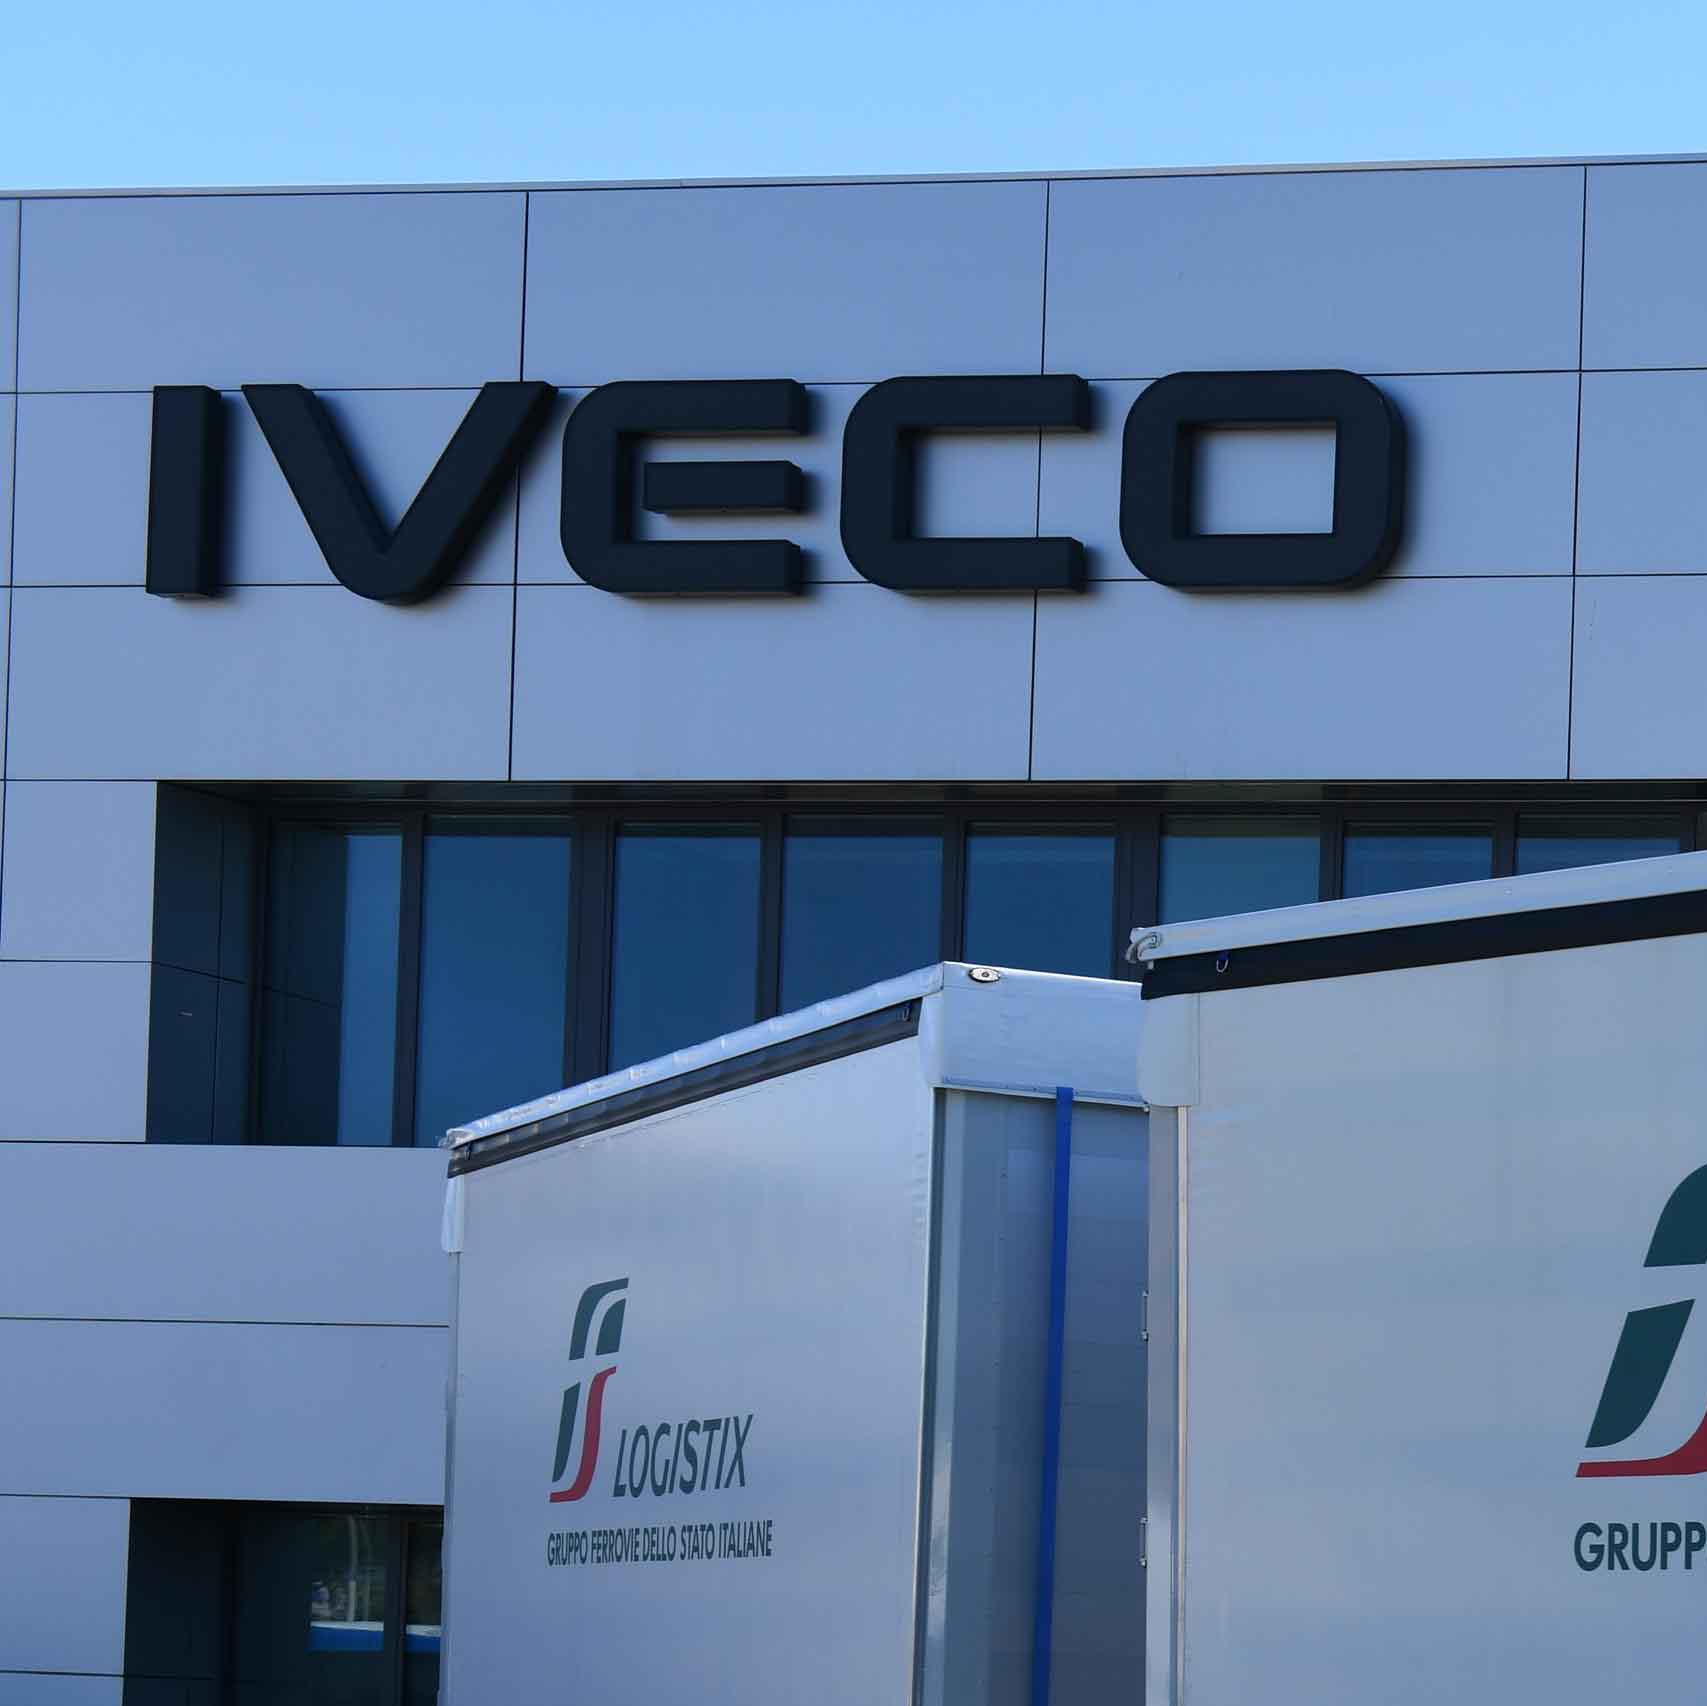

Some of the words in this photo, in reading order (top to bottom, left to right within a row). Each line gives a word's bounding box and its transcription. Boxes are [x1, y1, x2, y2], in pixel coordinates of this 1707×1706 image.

[146, 369, 1403, 606] IVECO
[613, 1414, 754, 1498] LOGISTIX
[547, 1530, 588, 1566] GRUPPO
[591, 1527, 640, 1564] FERROVIE
[642, 1525, 677, 1562] DELLO
[680, 1523, 715, 1560] STATO
[718, 1519, 773, 1559] ITALIANE
